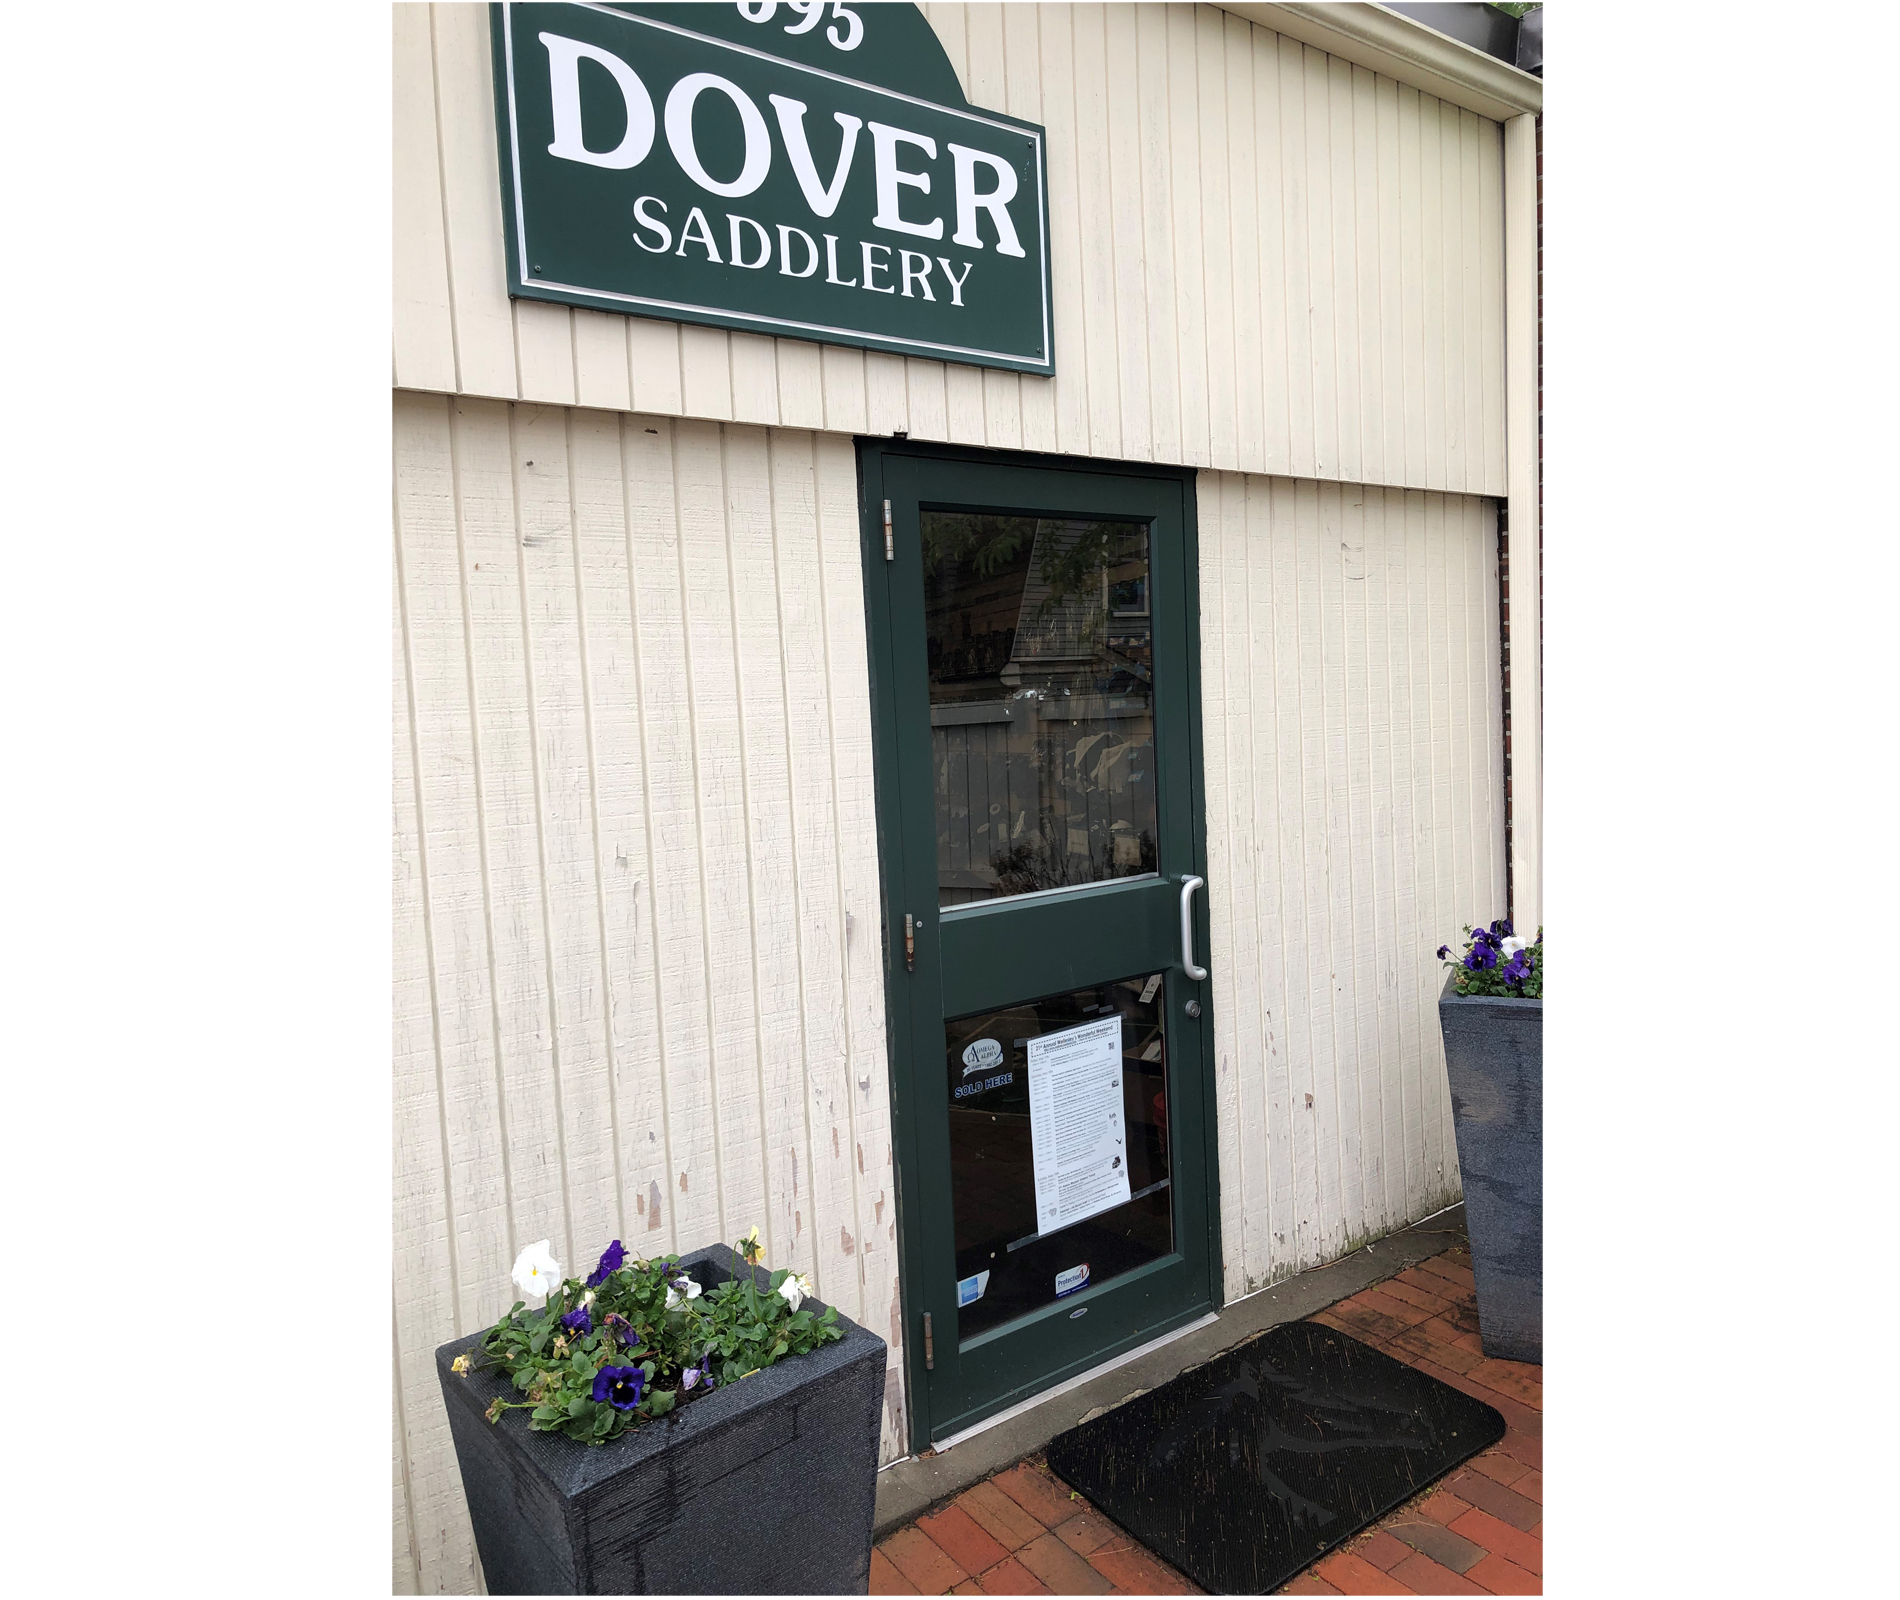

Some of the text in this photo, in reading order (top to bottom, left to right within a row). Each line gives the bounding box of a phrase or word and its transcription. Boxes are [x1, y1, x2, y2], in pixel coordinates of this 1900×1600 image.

[538, 31, 1026, 259] DOVER
[633, 195, 973, 307] SADDLERY
[977, 1045, 995, 1054] OMEGA
[981, 1050, 997, 1059] ALPHA
[955, 1081, 983, 1098] SOLD
[985, 1072, 1013, 1090] HERE
